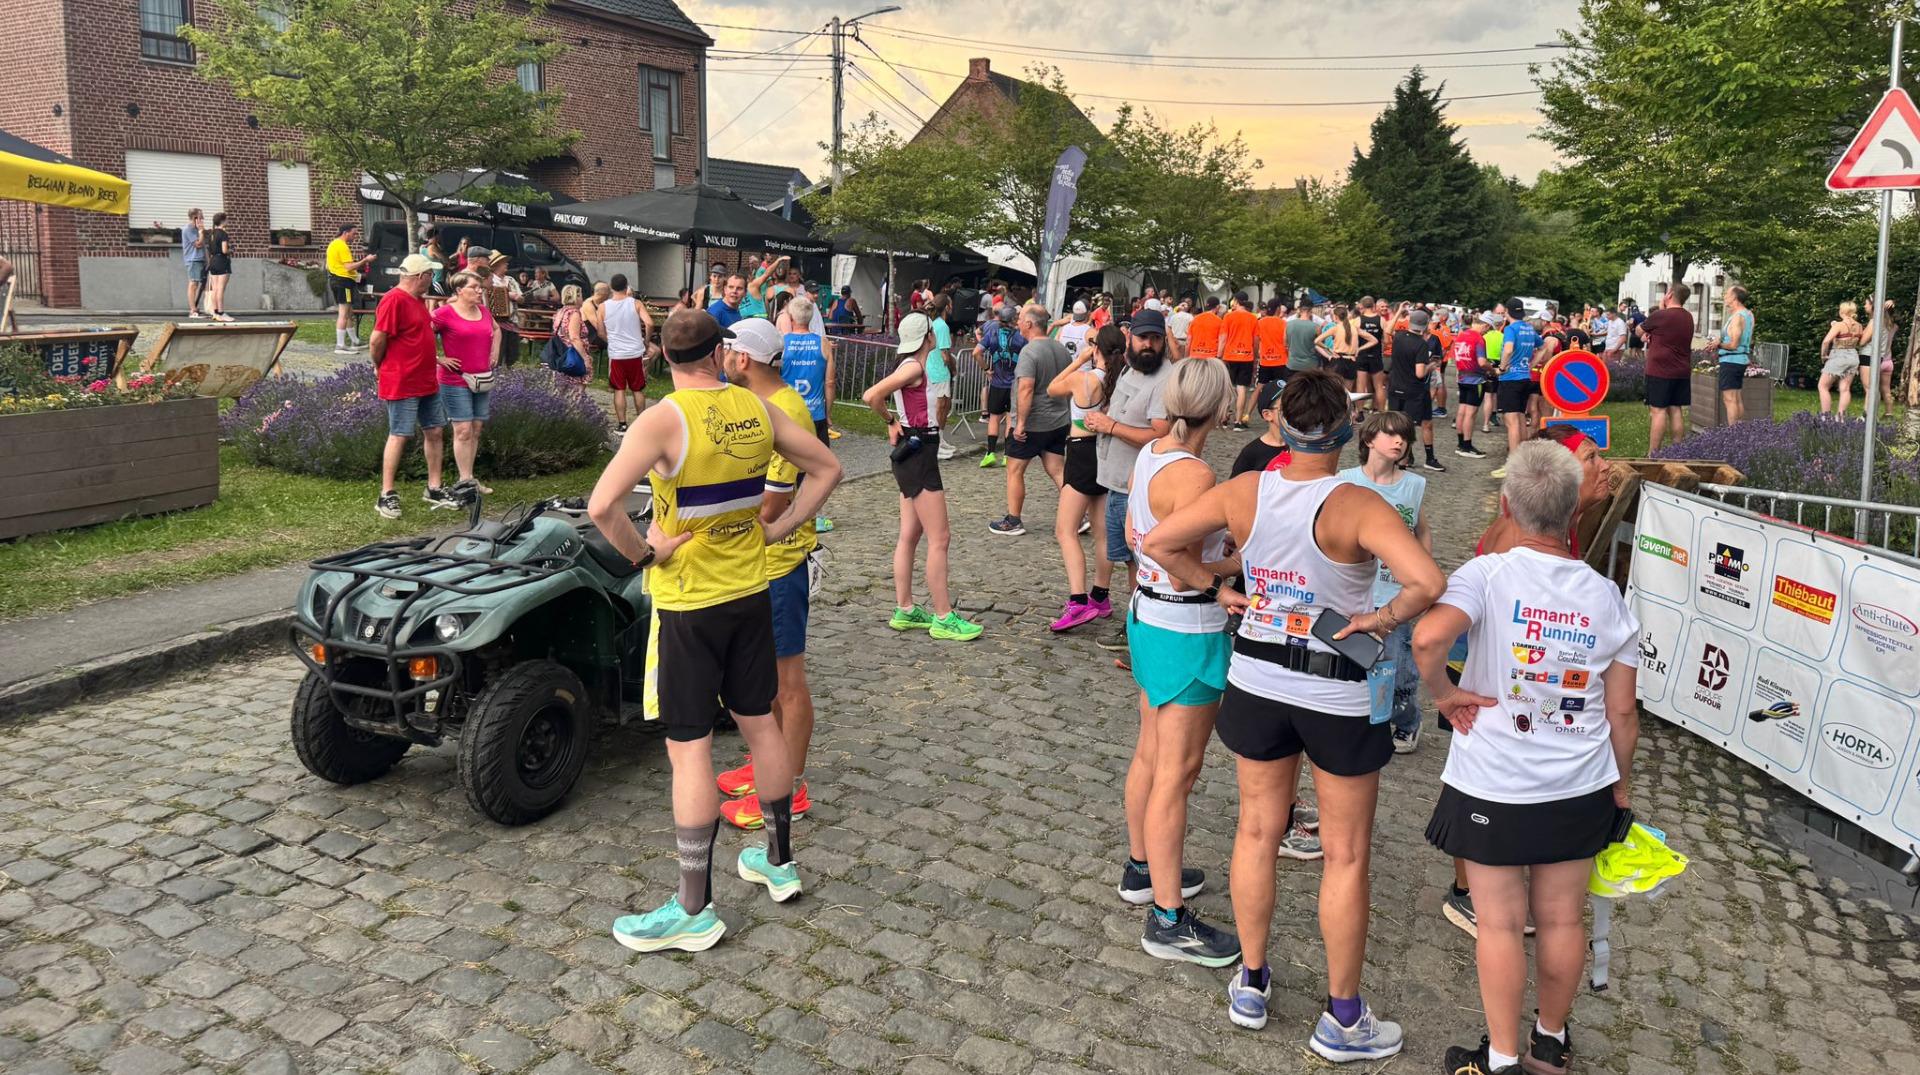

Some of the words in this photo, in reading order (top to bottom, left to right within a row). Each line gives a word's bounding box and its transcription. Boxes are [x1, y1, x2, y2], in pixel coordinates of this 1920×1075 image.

[28, 174, 65, 192] BELGIAN
[68, 181, 95, 197] BLOND
[98, 187, 118, 202] BEER
[554, 213, 571, 224] PAIX
[571, 214, 588, 226] DIEU
[613, 221, 630, 231] Triple
[630, 224, 648, 234] pleine
[648, 227, 655, 235] de
[765, 240, 779, 250] Triple
[725, 417, 760, 433] ATHOIS
[1245, 559, 1307, 586] Lamant's
[1255, 577, 1315, 604] Running
[1776, 577, 1834, 611] Thiébaut
[1512, 599, 1591, 628] Lamant's
[1856, 604, 1911, 633] Anti-chute
[1526, 620, 1597, 649] Running
[1888, 637, 1914, 652] TEXTILE
[1693, 692, 1722, 711] DUFOUR
[1832, 729, 1884, 763] HORTA
